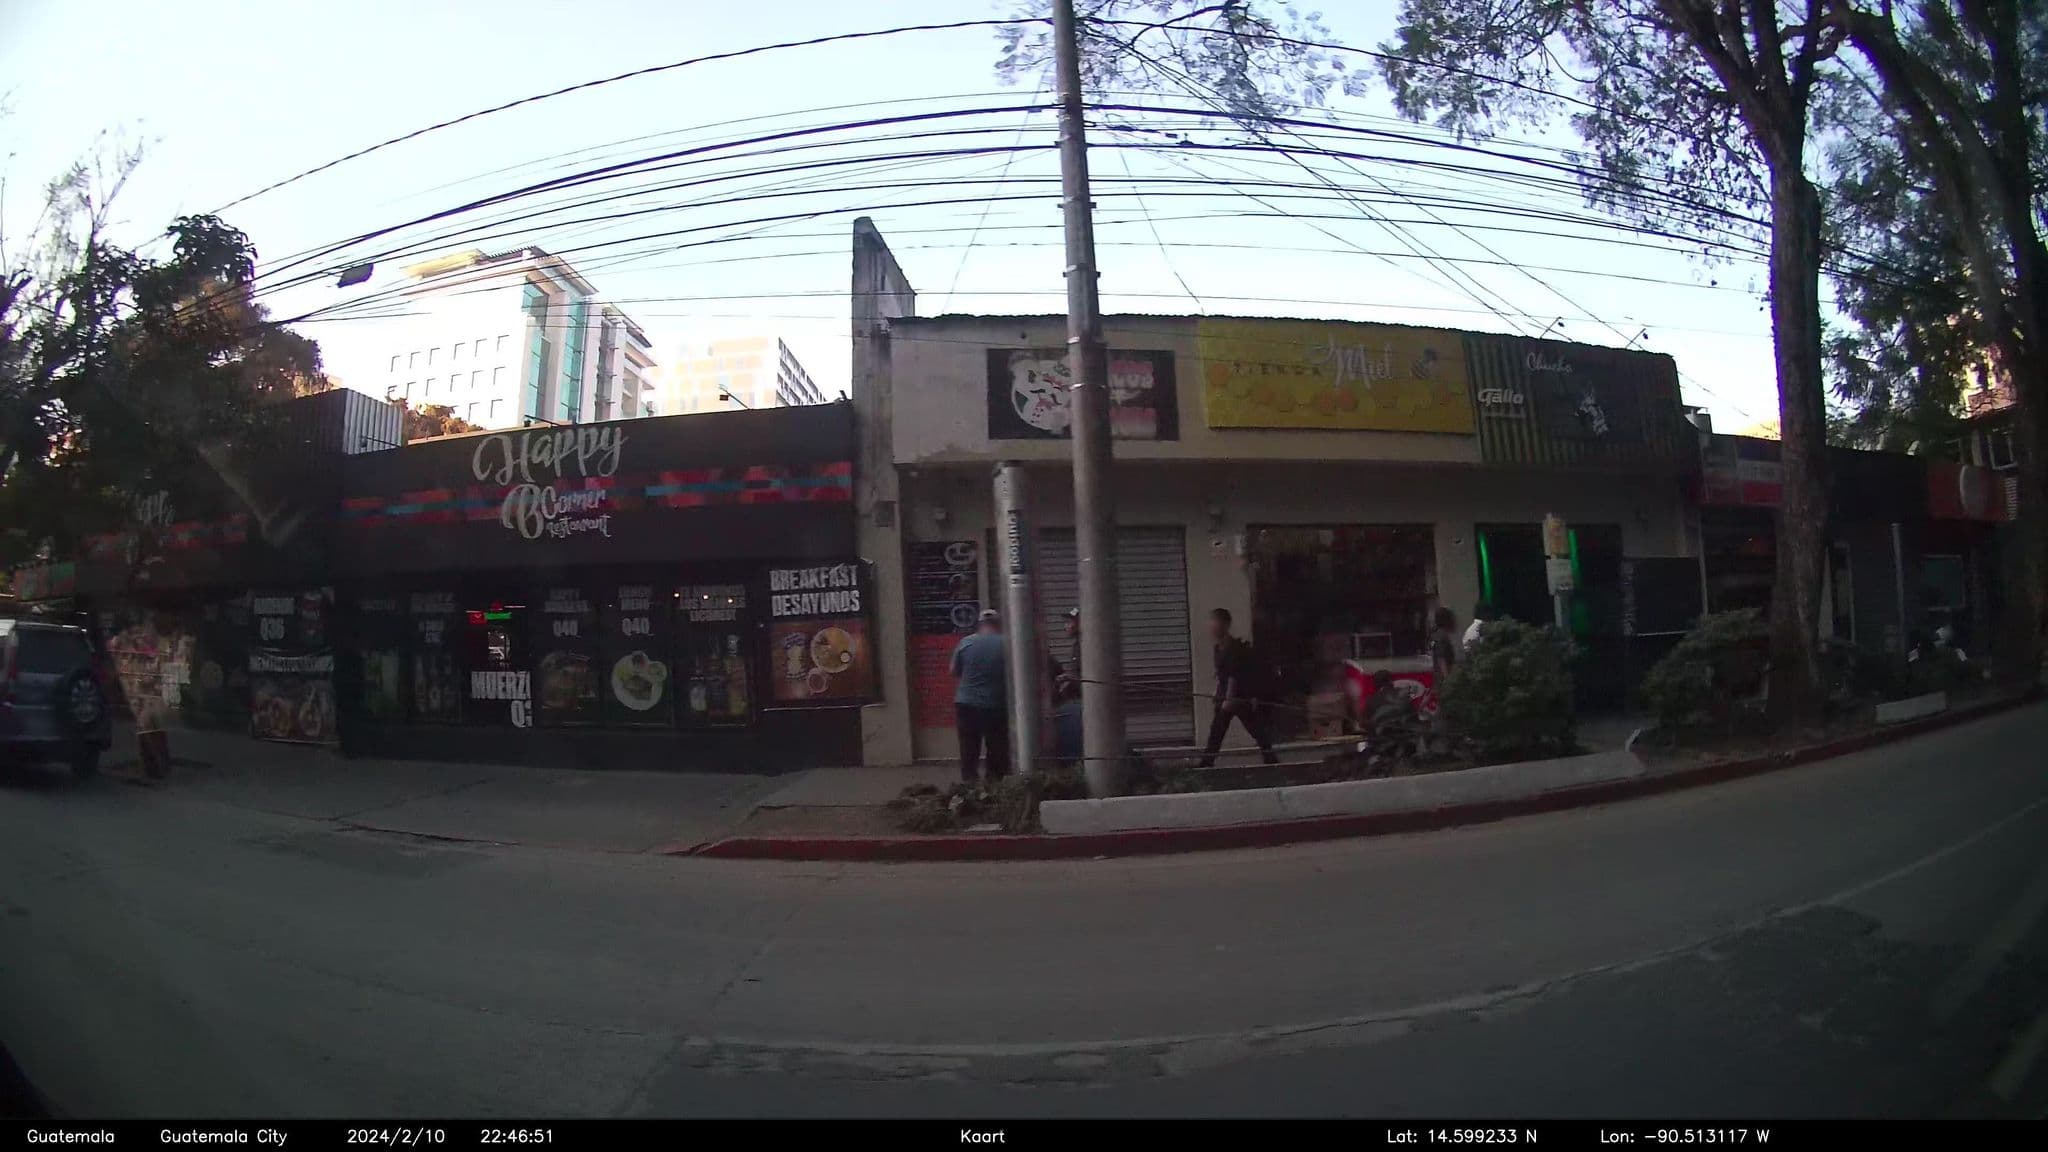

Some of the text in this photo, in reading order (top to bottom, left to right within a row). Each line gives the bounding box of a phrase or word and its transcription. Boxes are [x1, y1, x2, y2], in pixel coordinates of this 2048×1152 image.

[1477, 388, 1525, 406] Gallo
[472, 427, 628, 485] Happy
[541, 486, 606, 519] Corner
[769, 563, 858, 591] BREAKFAST
[772, 590, 860, 616] DESAYUNOS
